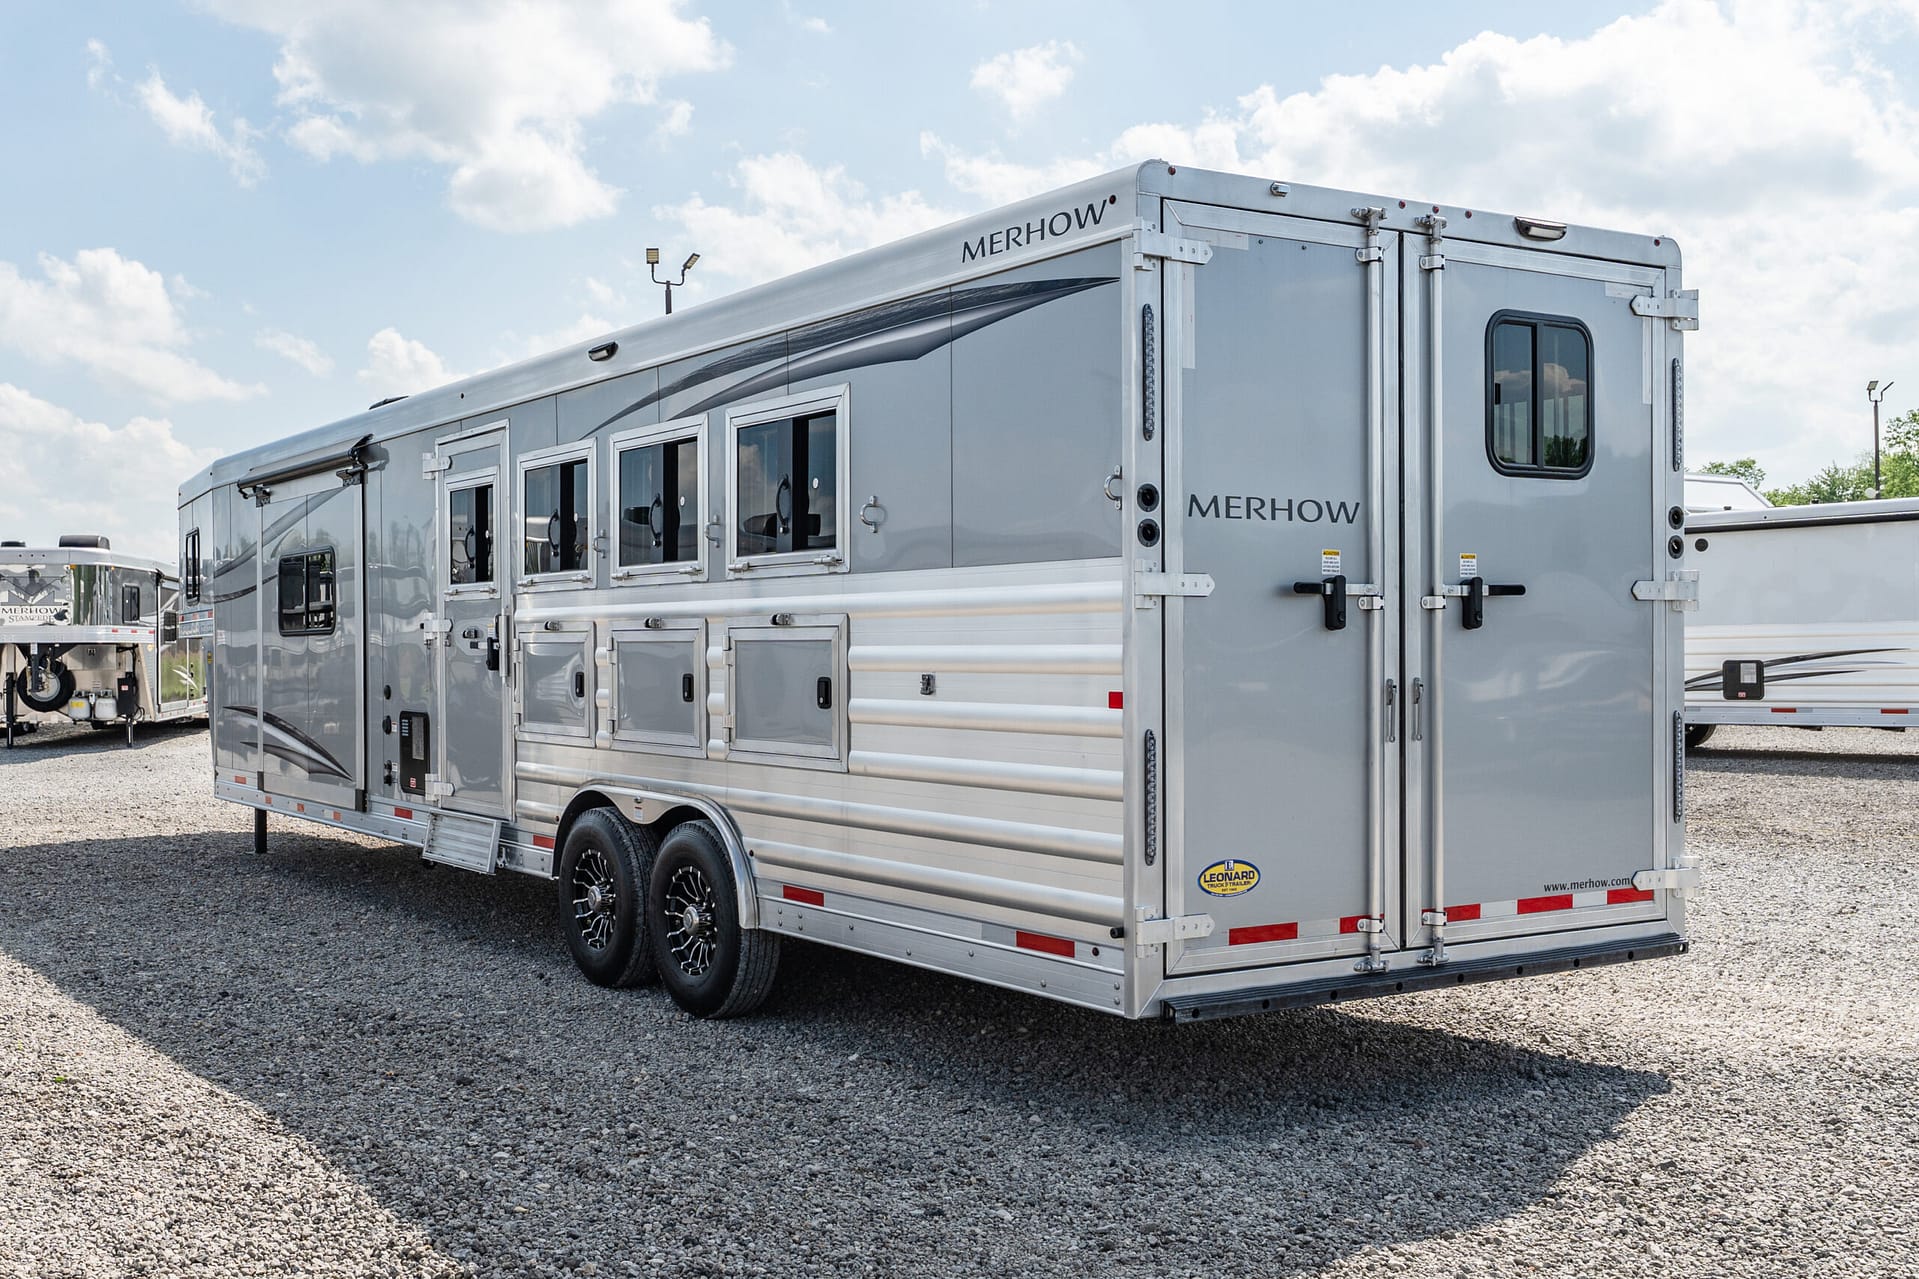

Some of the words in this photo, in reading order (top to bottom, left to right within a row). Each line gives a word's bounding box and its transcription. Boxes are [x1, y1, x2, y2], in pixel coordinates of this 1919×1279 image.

[962, 199, 1107, 263] MERHOW
[1188, 494, 1360, 524] MERHOW
[1204, 870, 1255, 883] LEONARD
[1544, 876, 1632, 892] www.merhow.com
